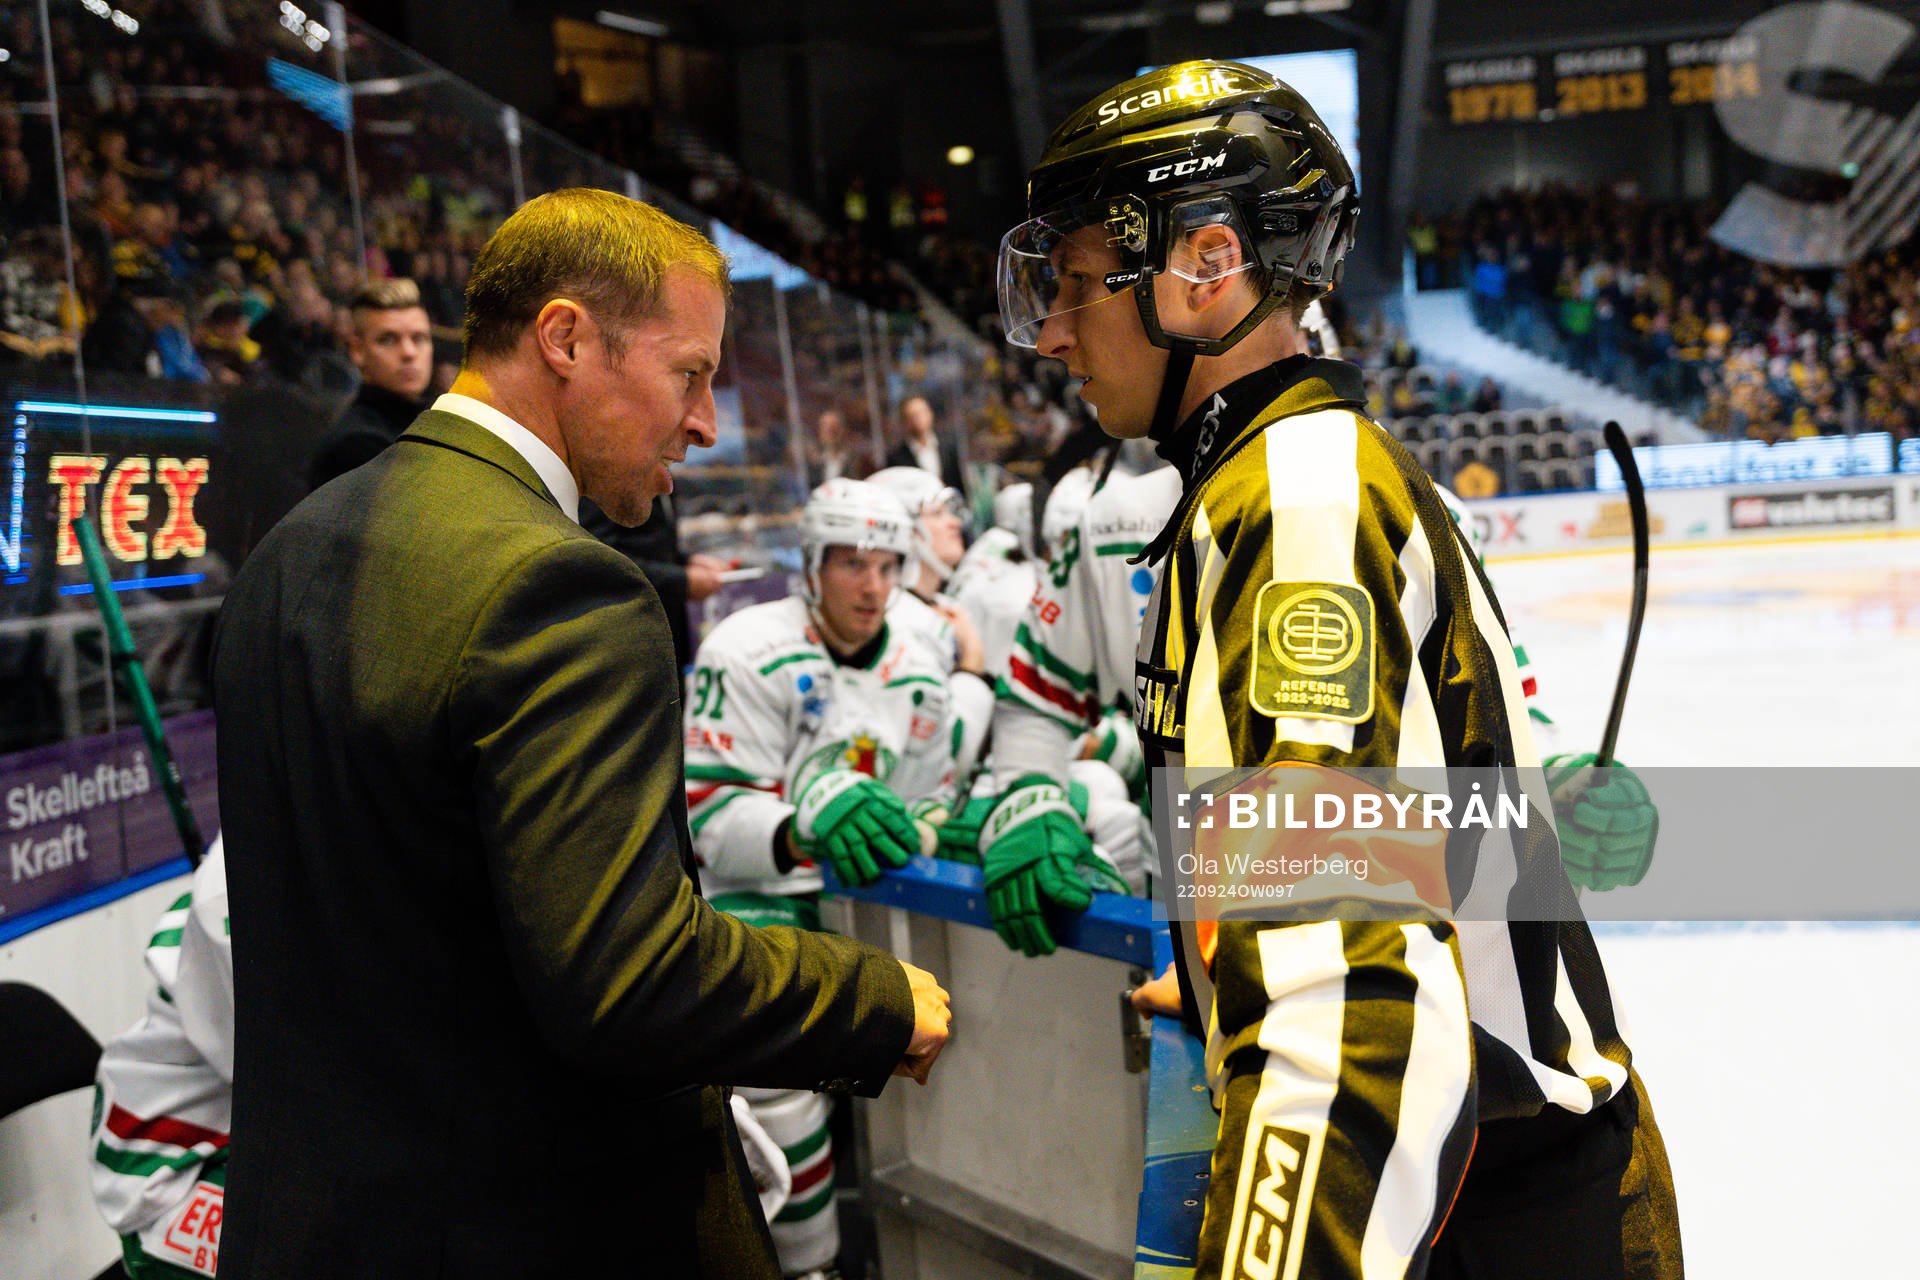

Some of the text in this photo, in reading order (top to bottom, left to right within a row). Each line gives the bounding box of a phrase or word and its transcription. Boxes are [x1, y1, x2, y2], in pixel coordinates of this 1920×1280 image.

[1098, 71, 1242, 126] Scandic
[1147, 152, 1227, 183] CCM
[1105, 272, 1139, 284] CCM
[48, 452, 210, 566] TEX
[693, 665, 727, 719] 91
[1273, 692, 1350, 709] 1922-2022
[1280, 680, 1346, 694] REFEREE
[6, 751, 150, 830] Skellefteå
[11, 823, 89, 882] Kraft
[1239, 1132, 1301, 1280] CM
